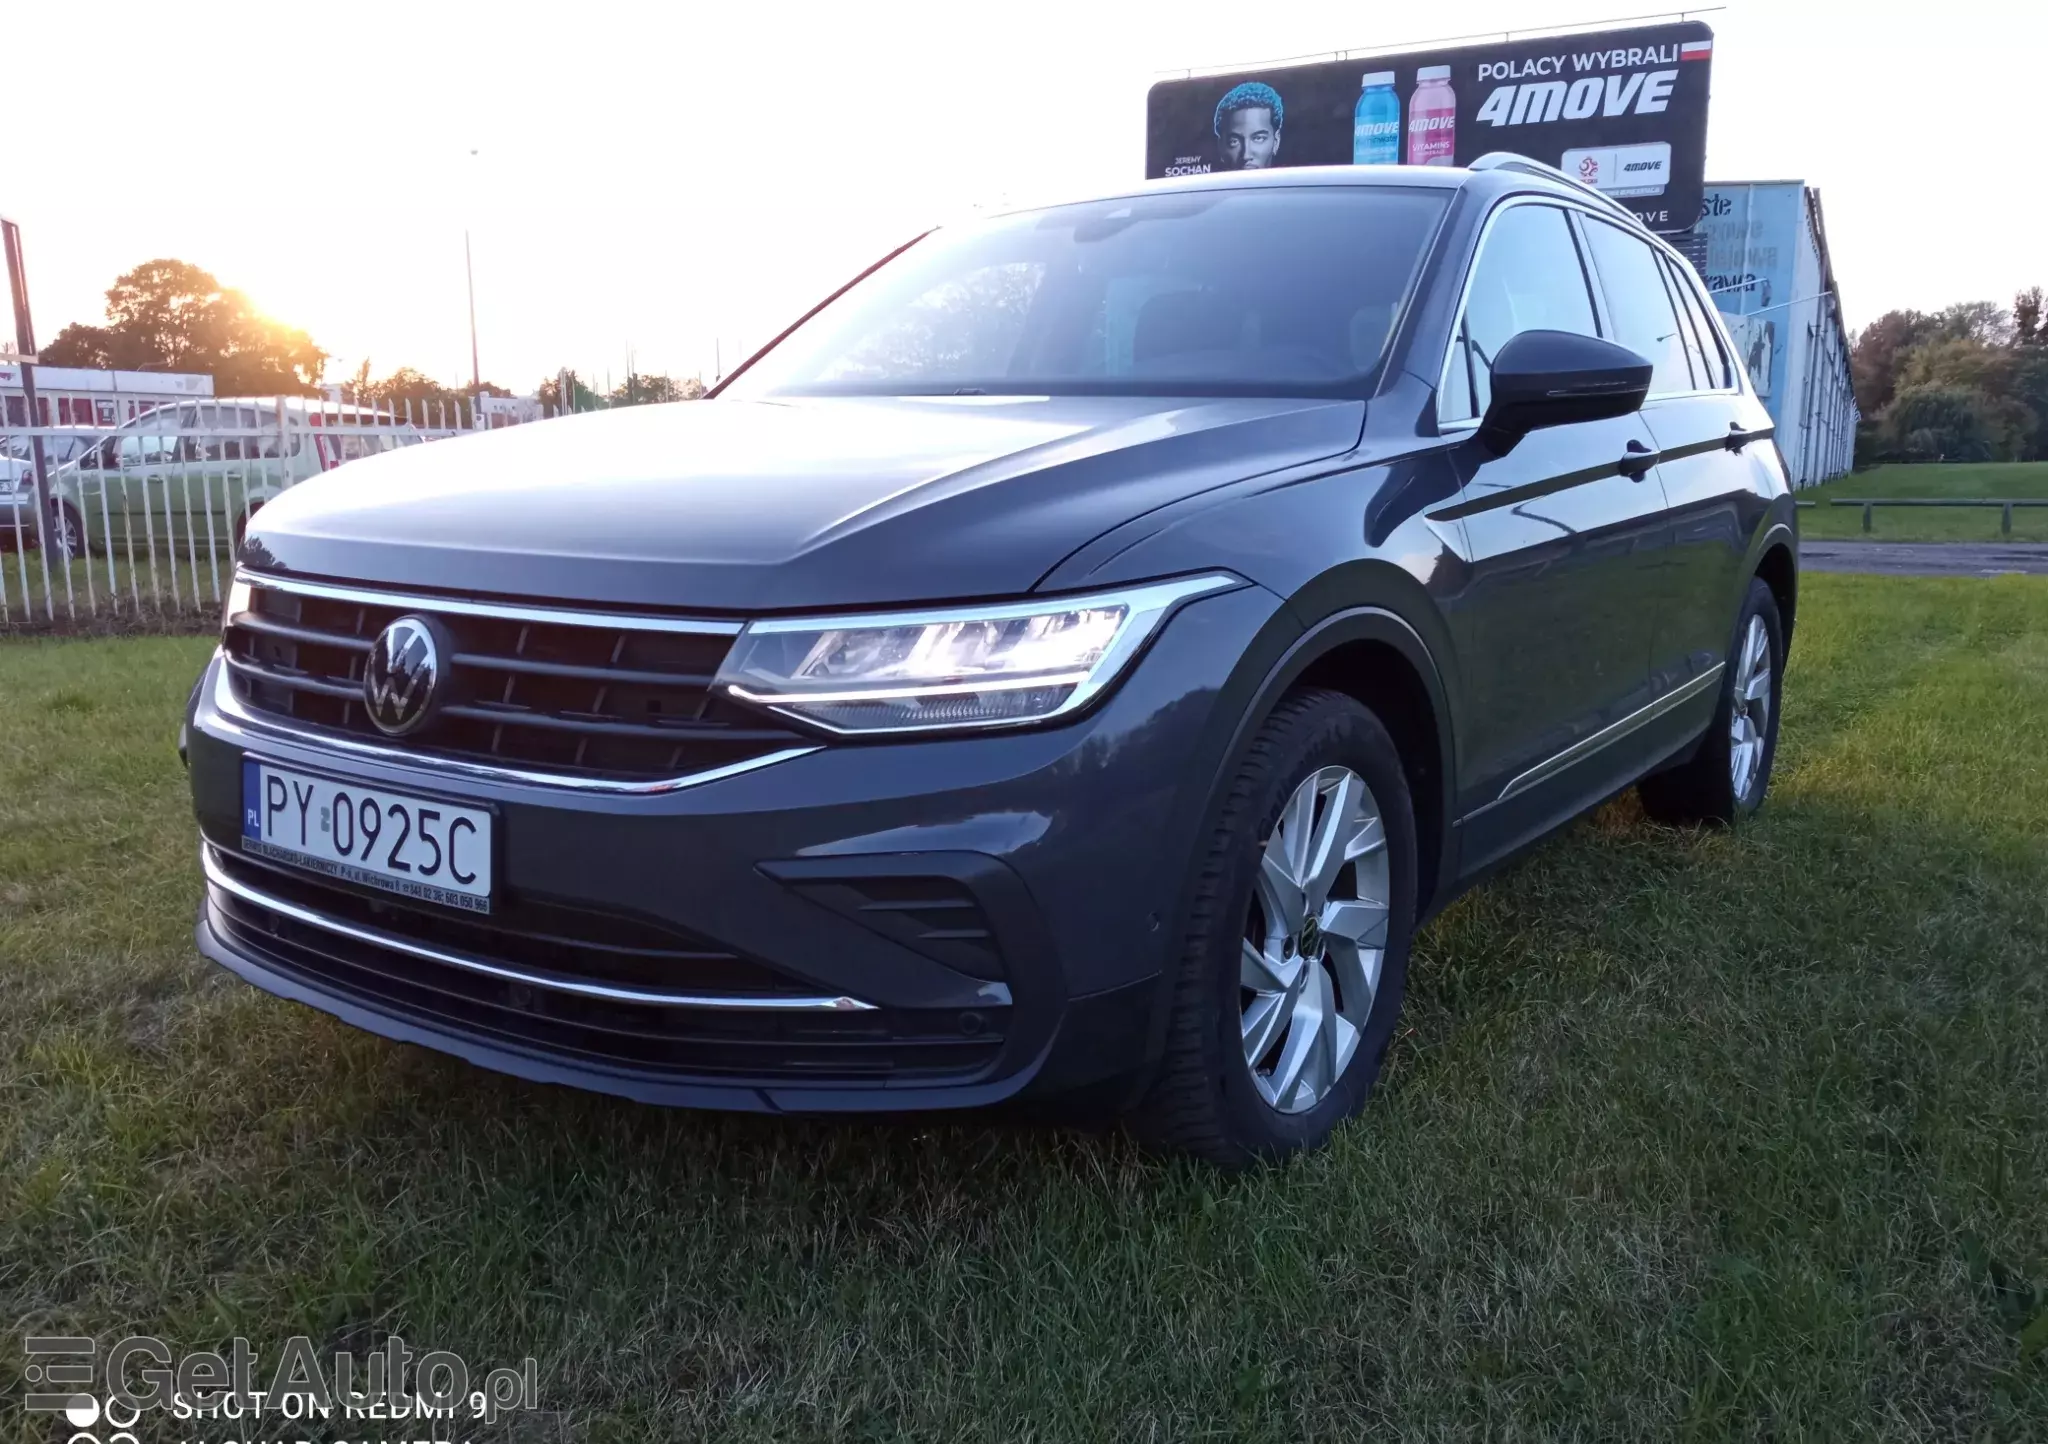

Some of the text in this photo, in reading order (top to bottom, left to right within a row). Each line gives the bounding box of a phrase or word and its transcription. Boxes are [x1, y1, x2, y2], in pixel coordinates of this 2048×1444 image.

[1477, 43, 1679, 82] POLACY WYBRALI
[1476, 69, 1679, 127] 4MOVE
[1165, 163, 1211, 177] SOCHAN
[1623, 161, 1662, 171] 4MOVE
[247, 808, 260, 828] PL
[266, 774, 478, 885] PY 0925C
